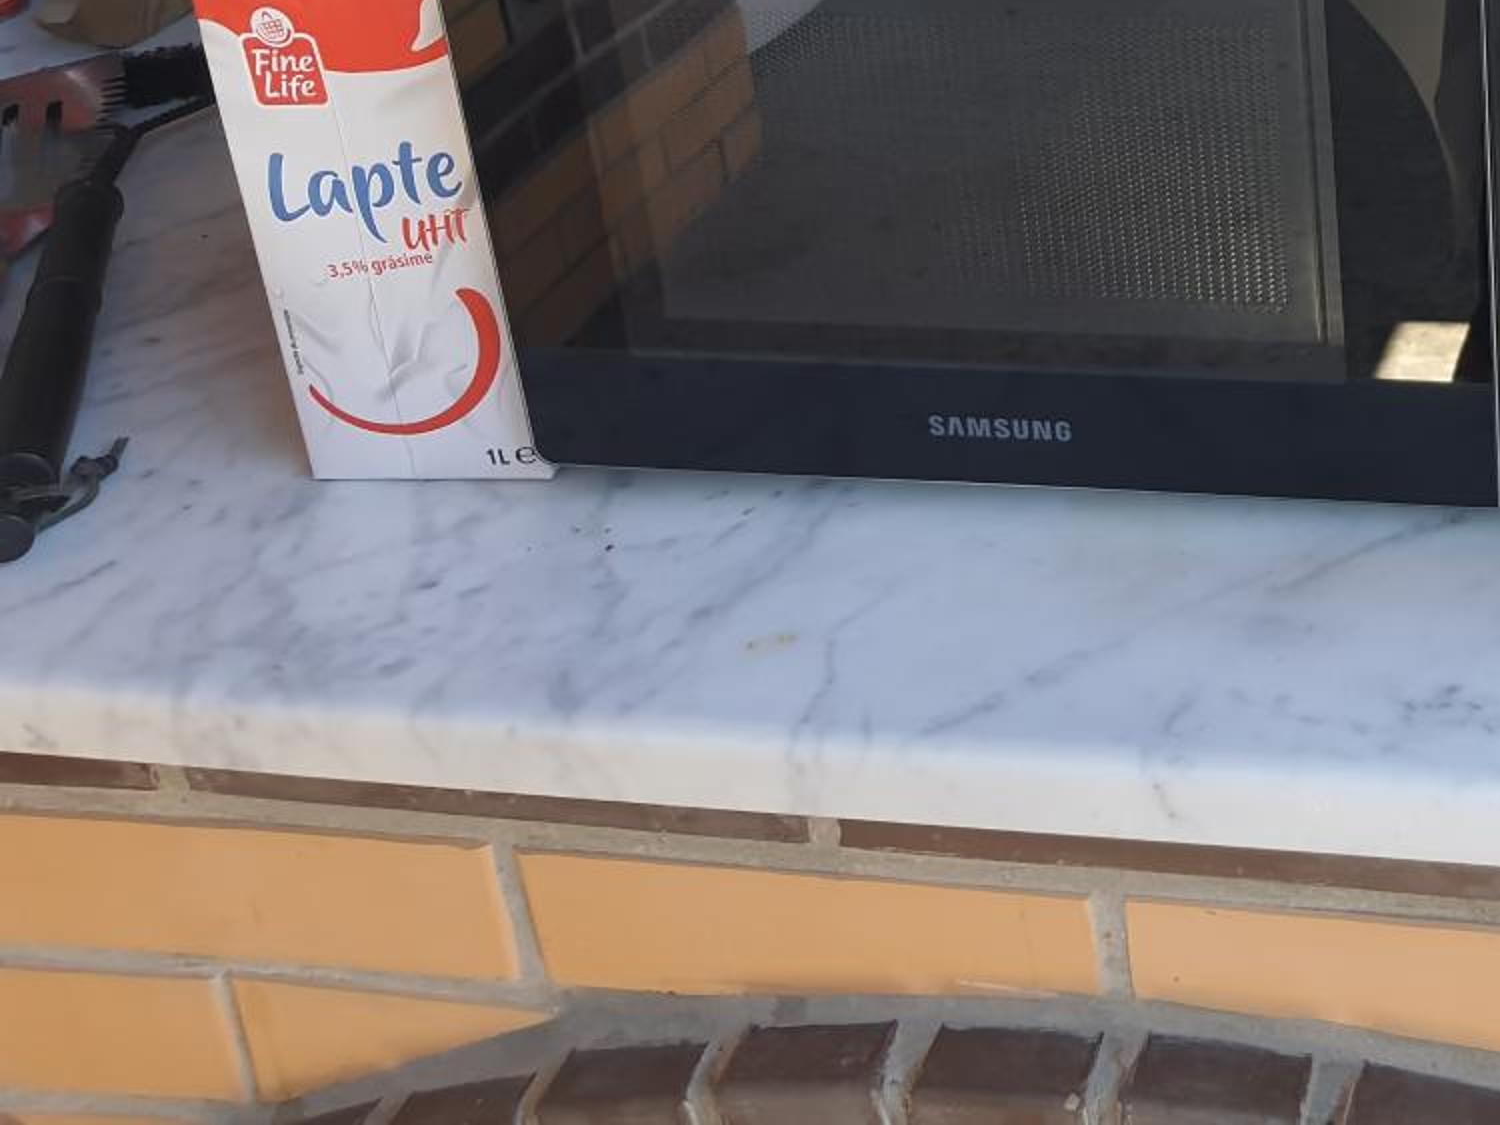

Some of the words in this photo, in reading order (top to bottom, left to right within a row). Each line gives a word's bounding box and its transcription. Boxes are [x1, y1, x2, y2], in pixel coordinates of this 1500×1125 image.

[252, 48, 315, 75] Fine
[263, 73, 318, 105] Life
[267, 140, 463, 244] Lapte
[400, 206, 472, 254] UHT
[327, 260, 369, 279] 3,5%
[928, 414, 1073, 443] SAMSUNG
[486, 447, 511, 467] 1L
